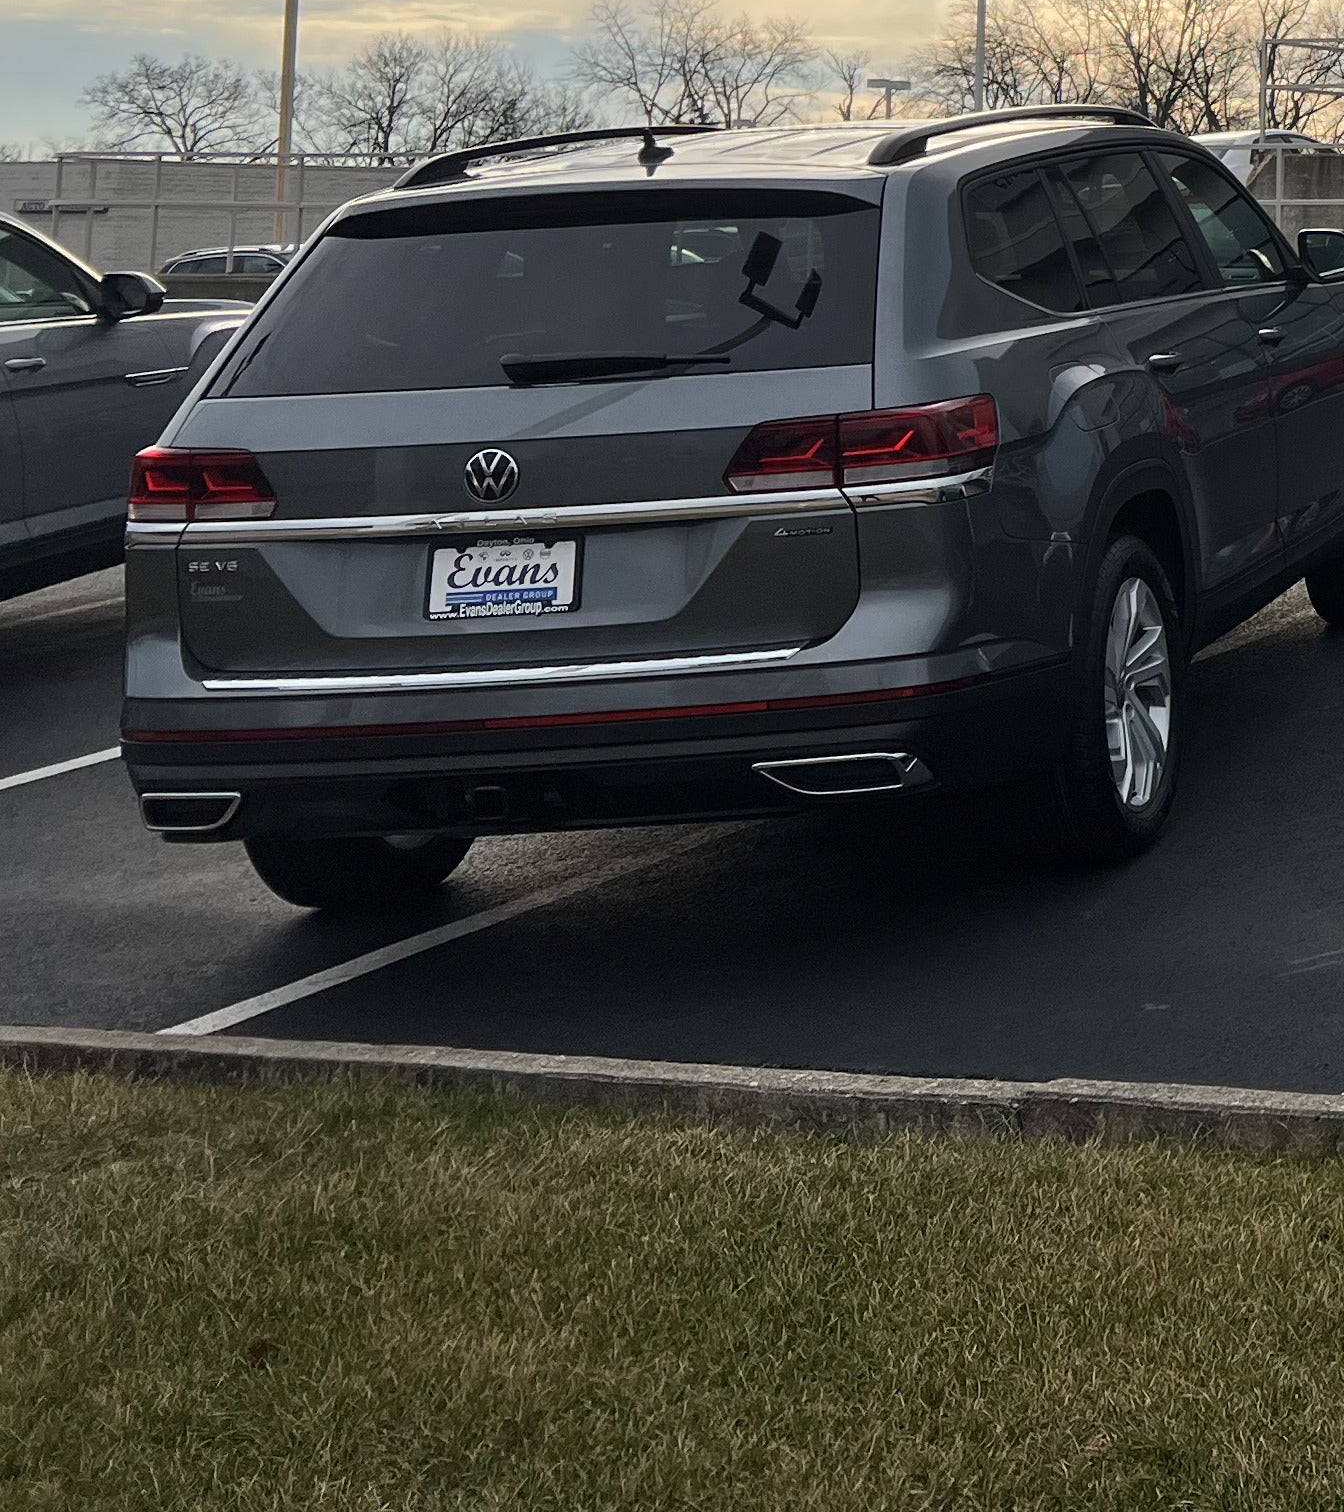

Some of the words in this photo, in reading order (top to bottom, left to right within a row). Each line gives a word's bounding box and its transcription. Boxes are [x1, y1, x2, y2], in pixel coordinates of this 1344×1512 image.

[513, 536, 535, 545] Ohio
[188, 561, 211, 573] SE
[447, 553, 560, 589] Evans
[485, 591, 520, 602] DEALER
[522, 589, 554, 600] GROUP
[429, 599, 570, 620] www.EvansDealerGroup.com
